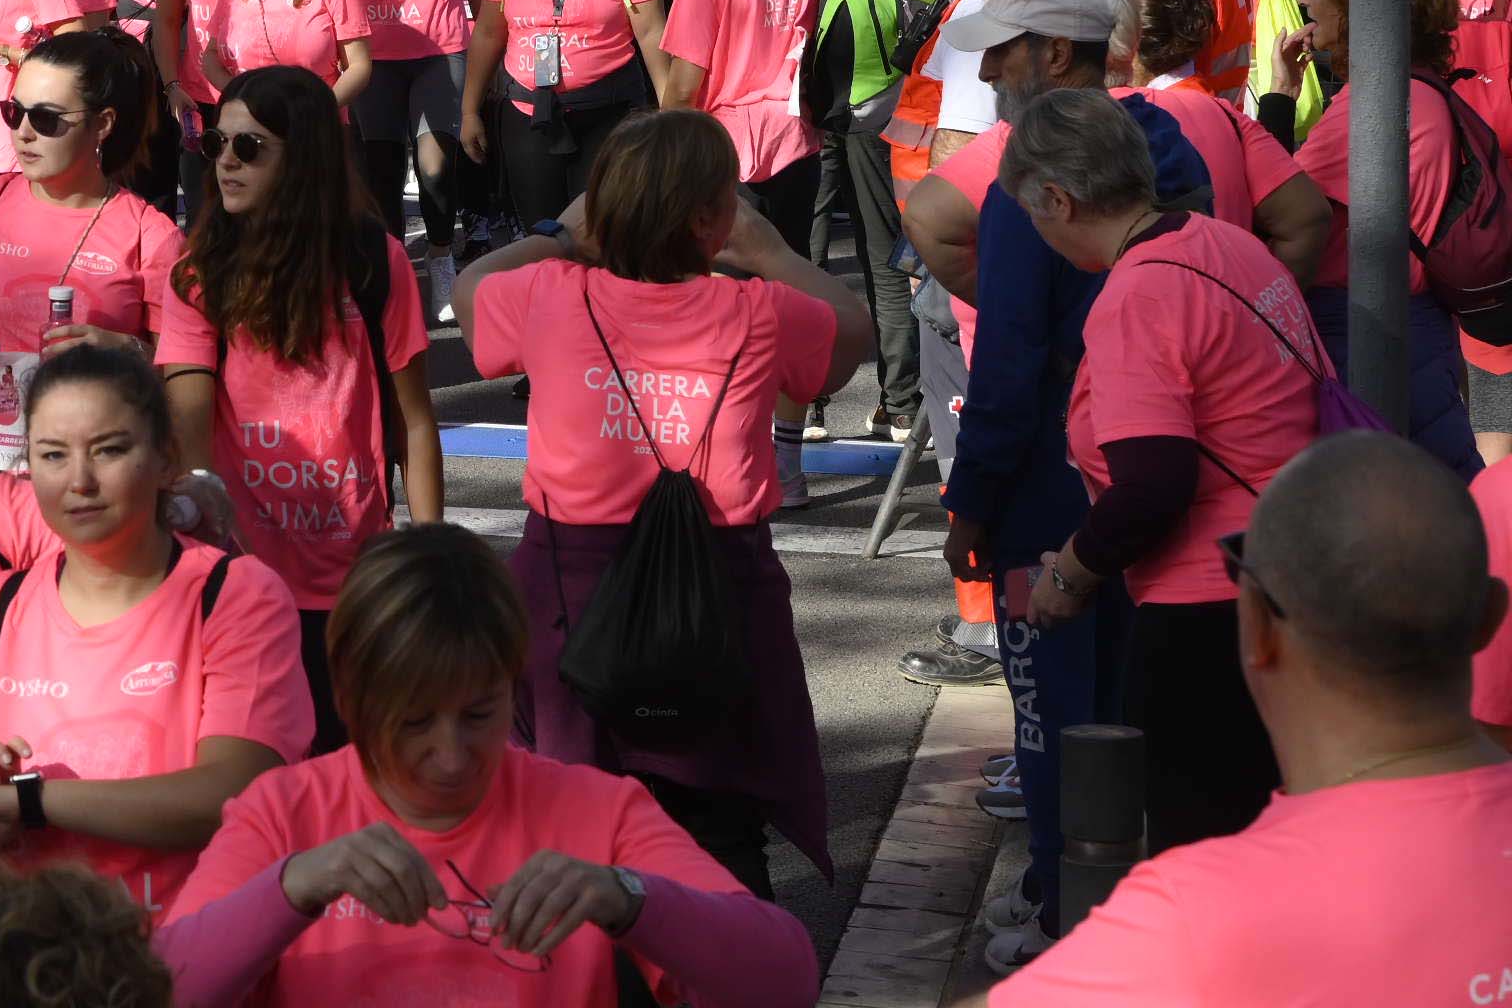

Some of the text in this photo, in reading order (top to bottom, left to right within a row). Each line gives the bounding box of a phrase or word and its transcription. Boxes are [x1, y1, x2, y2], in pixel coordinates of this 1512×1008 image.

[193, 4, 210, 22] TU
[367, 5, 421, 20] SUMA
[518, 54, 571, 72] SUA
[584, 367, 711, 398] CARRERA
[607, 393, 686, 421] DE LA
[241, 419, 281, 449] TU
[599, 417, 690, 445] MUJER
[243, 455, 369, 489] DORSAL
[0, 677, 69, 699] OYSHO
